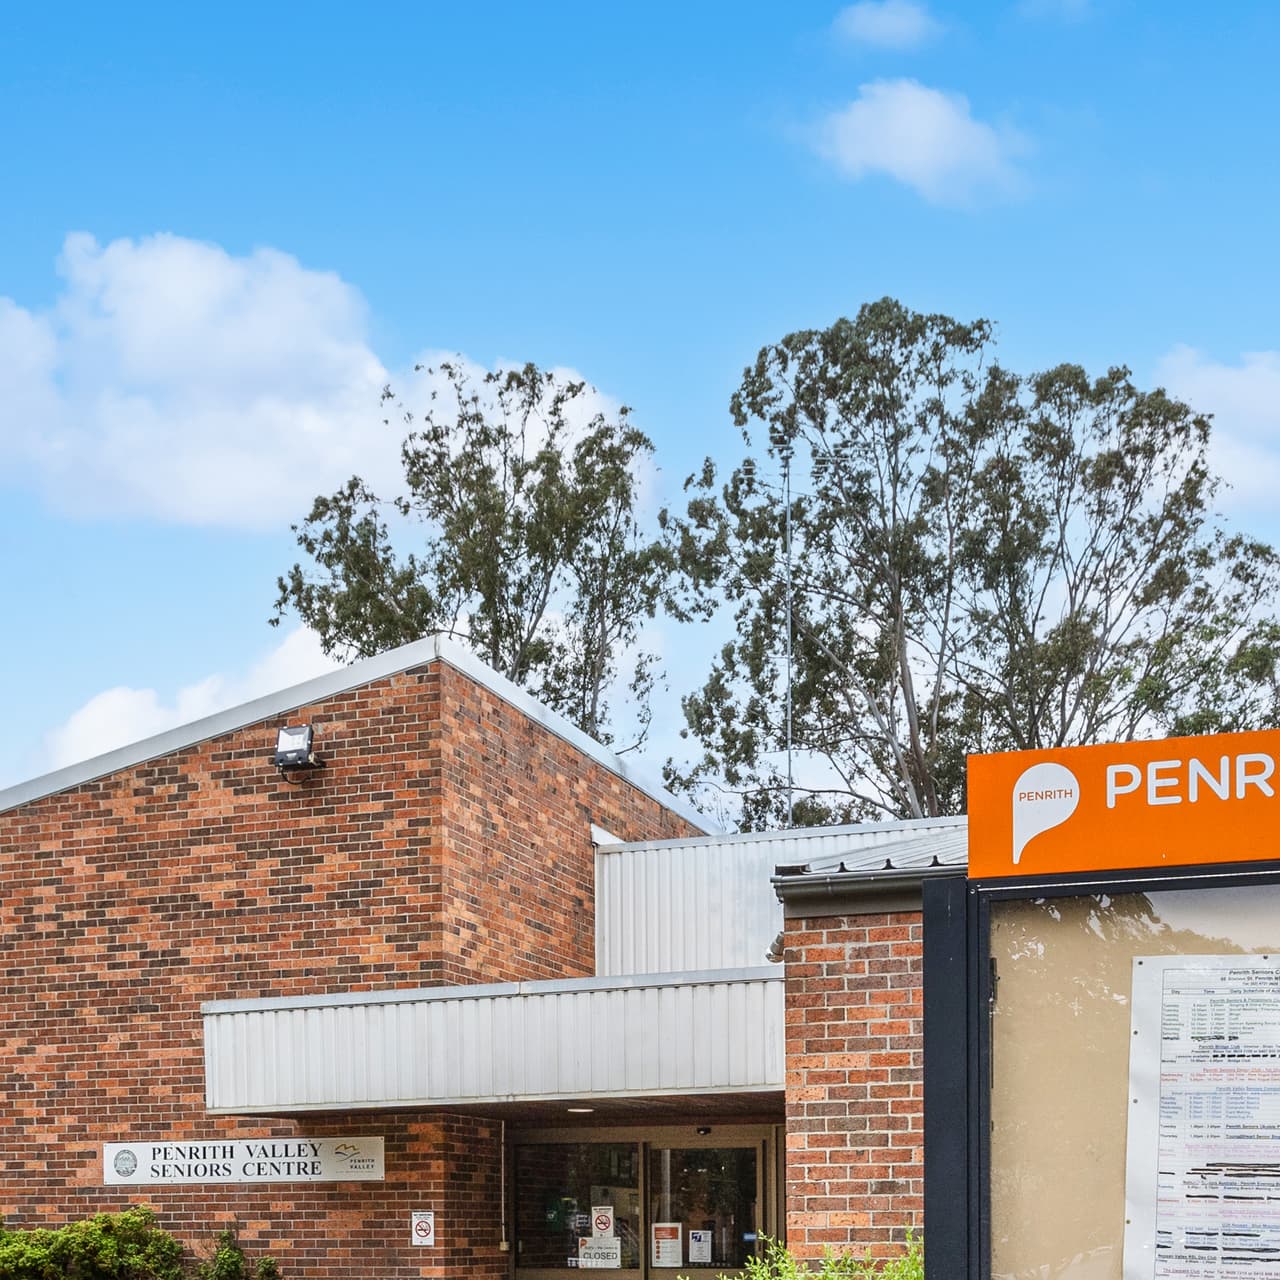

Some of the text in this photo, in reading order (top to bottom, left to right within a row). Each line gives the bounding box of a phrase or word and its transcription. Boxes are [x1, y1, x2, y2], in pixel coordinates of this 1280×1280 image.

[1018, 790, 1074, 801] PENRITH
[151, 1142, 323, 1161] PENRITH VALLEY
[149, 1163, 233, 1178] SENIORS
[241, 1161, 323, 1177] CENTRE
[583, 1251, 618, 1261] CLOSED
